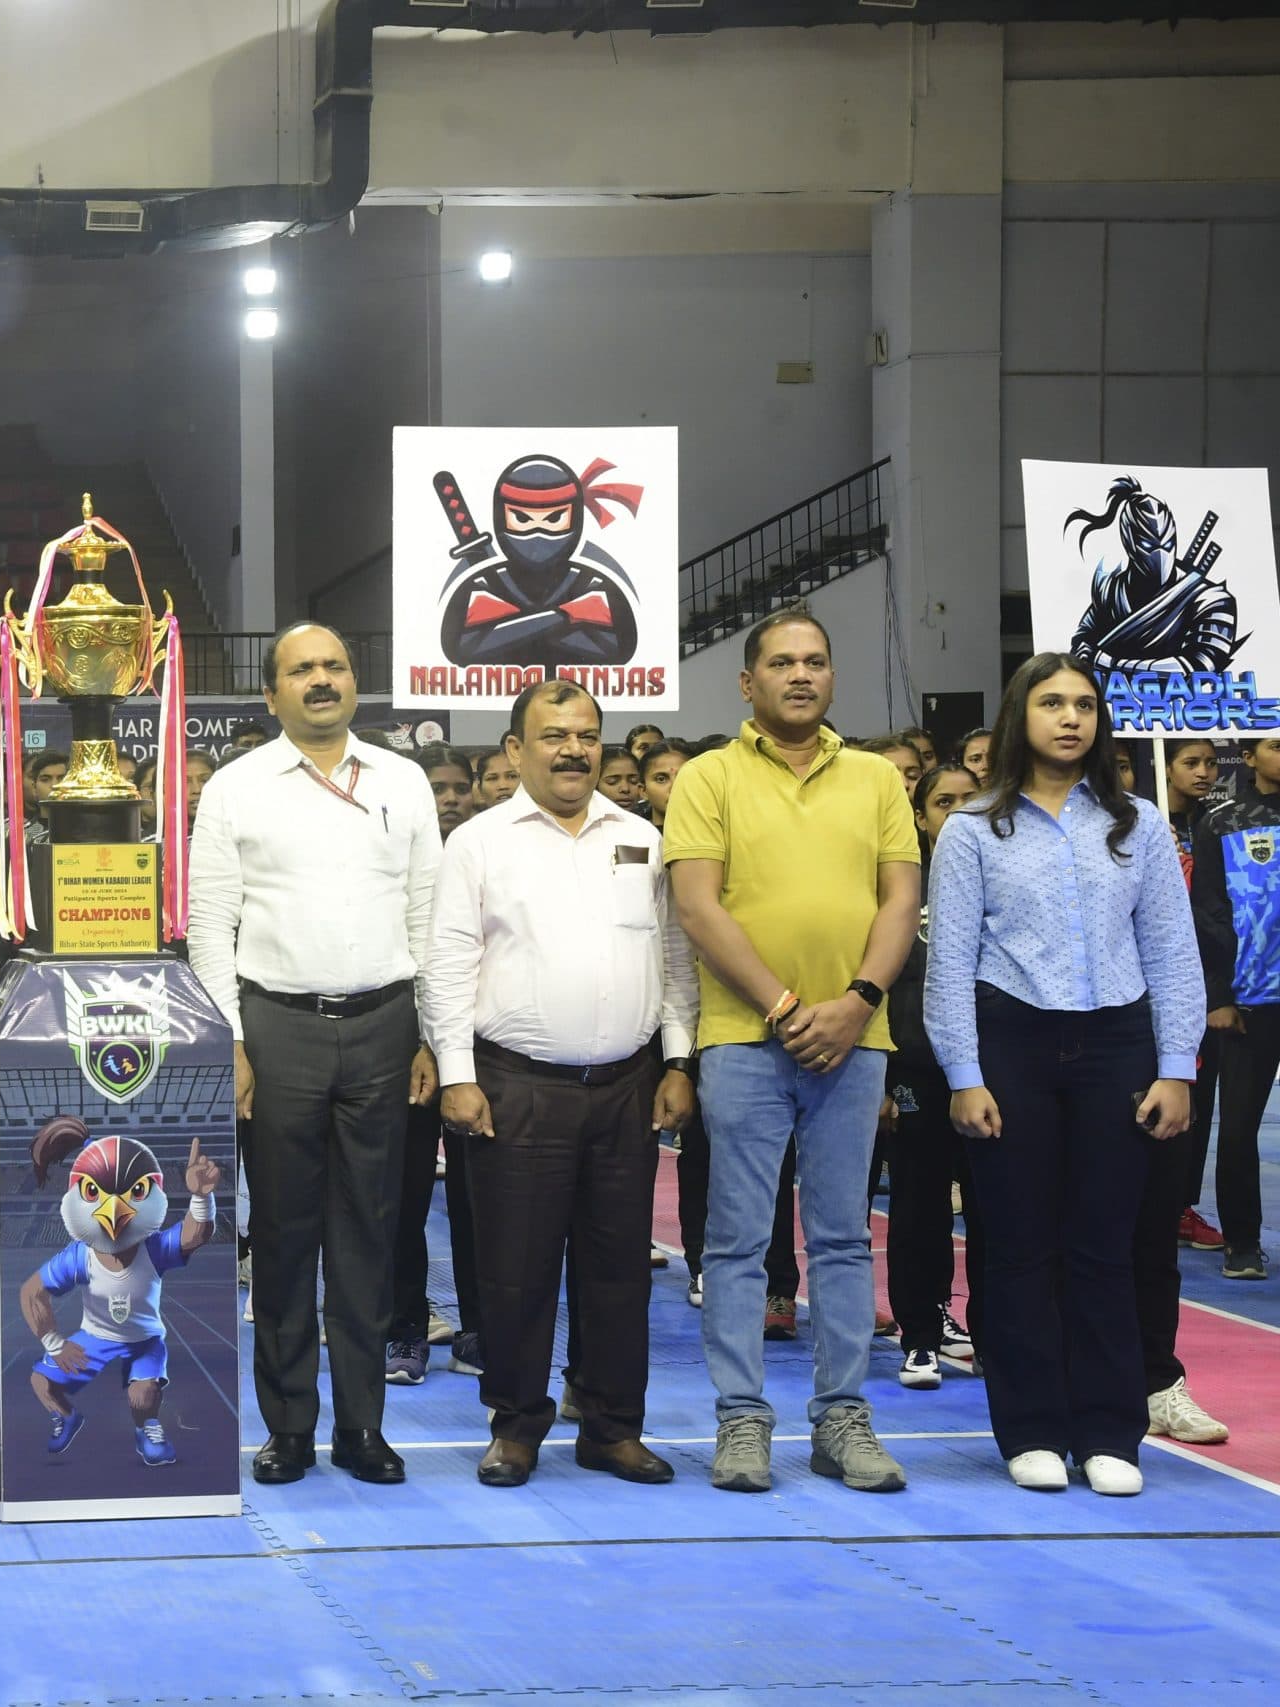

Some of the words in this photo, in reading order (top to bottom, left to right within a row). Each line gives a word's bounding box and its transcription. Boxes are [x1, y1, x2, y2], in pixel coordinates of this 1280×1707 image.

[410, 665, 543, 696] NALANDA
[1094, 671, 1257, 701] AGADH
[1111, 698, 1280, 731] RRIORS
[112, 718, 153, 738] HAR
[185, 717, 253, 737] OME
[63, 877, 81, 885] BIHAR
[82, 876, 104, 885] WOMEN
[105, 876, 131, 885] KABADDI
[131, 875, 152, 885] LEAGUE
[58, 908, 151, 922] CHAMPIONS
[59, 940, 77, 948] Bihar
[79, 940, 95, 948] State
[96, 940, 118, 949] Sports
[120, 939, 151, 949] Authority
[79, 1014, 162, 1037] BWKL
